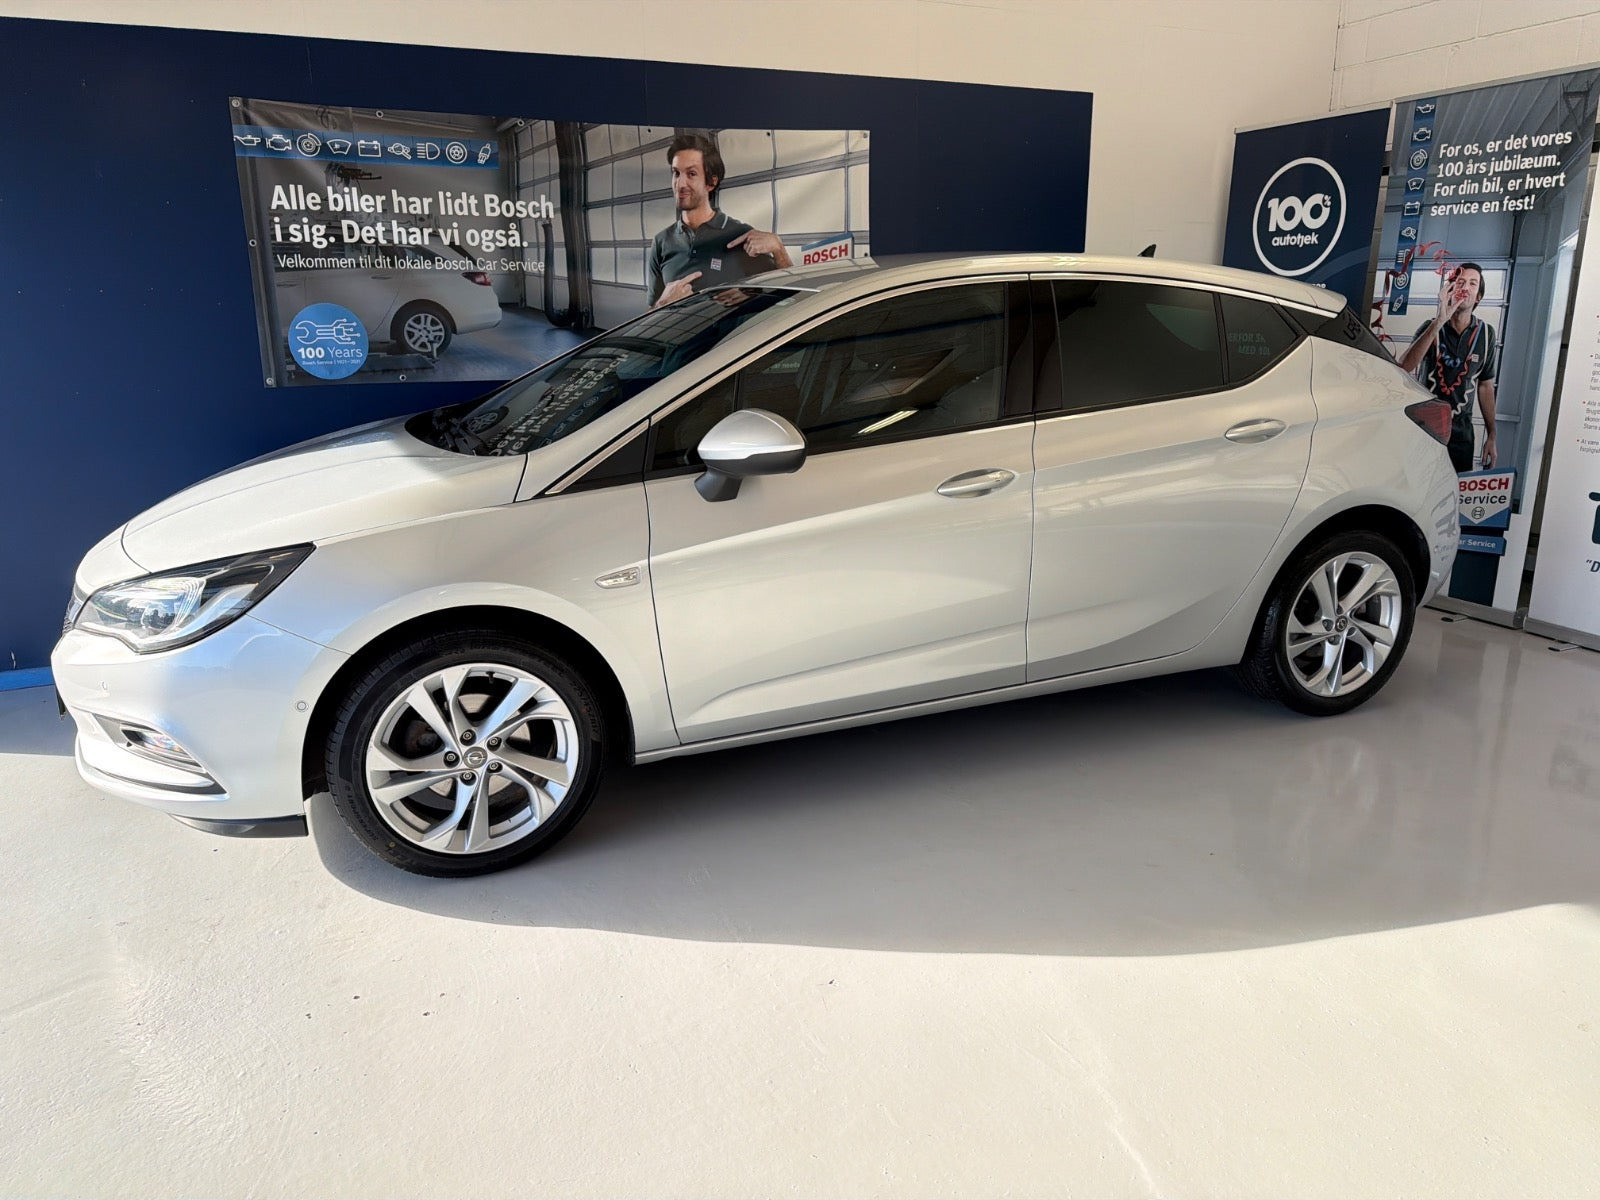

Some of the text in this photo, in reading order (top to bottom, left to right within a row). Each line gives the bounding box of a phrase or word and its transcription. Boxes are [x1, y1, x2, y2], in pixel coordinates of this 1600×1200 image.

[1439, 131, 1572, 158] For os, er det vores
[1437, 154, 1561, 178] 100 års jubilæum.
[1433, 172, 1566, 197] For din bil, er hvert
[271, 184, 555, 219] Alle biler har lidt Bosch
[1430, 195, 1535, 217] service en fest!
[273, 216, 529, 253] i sig. Det har vi også.
[277, 253, 545, 272] Velkommen til dit lokale Bosch Car Service
[803, 243, 849, 265] BOSCH
[297, 346, 363, 359] 100 Years
[1459, 477, 1510, 492] BOSCH
[1459, 493, 1507, 505] Service
[1467, 539, 1497, 549] Service
